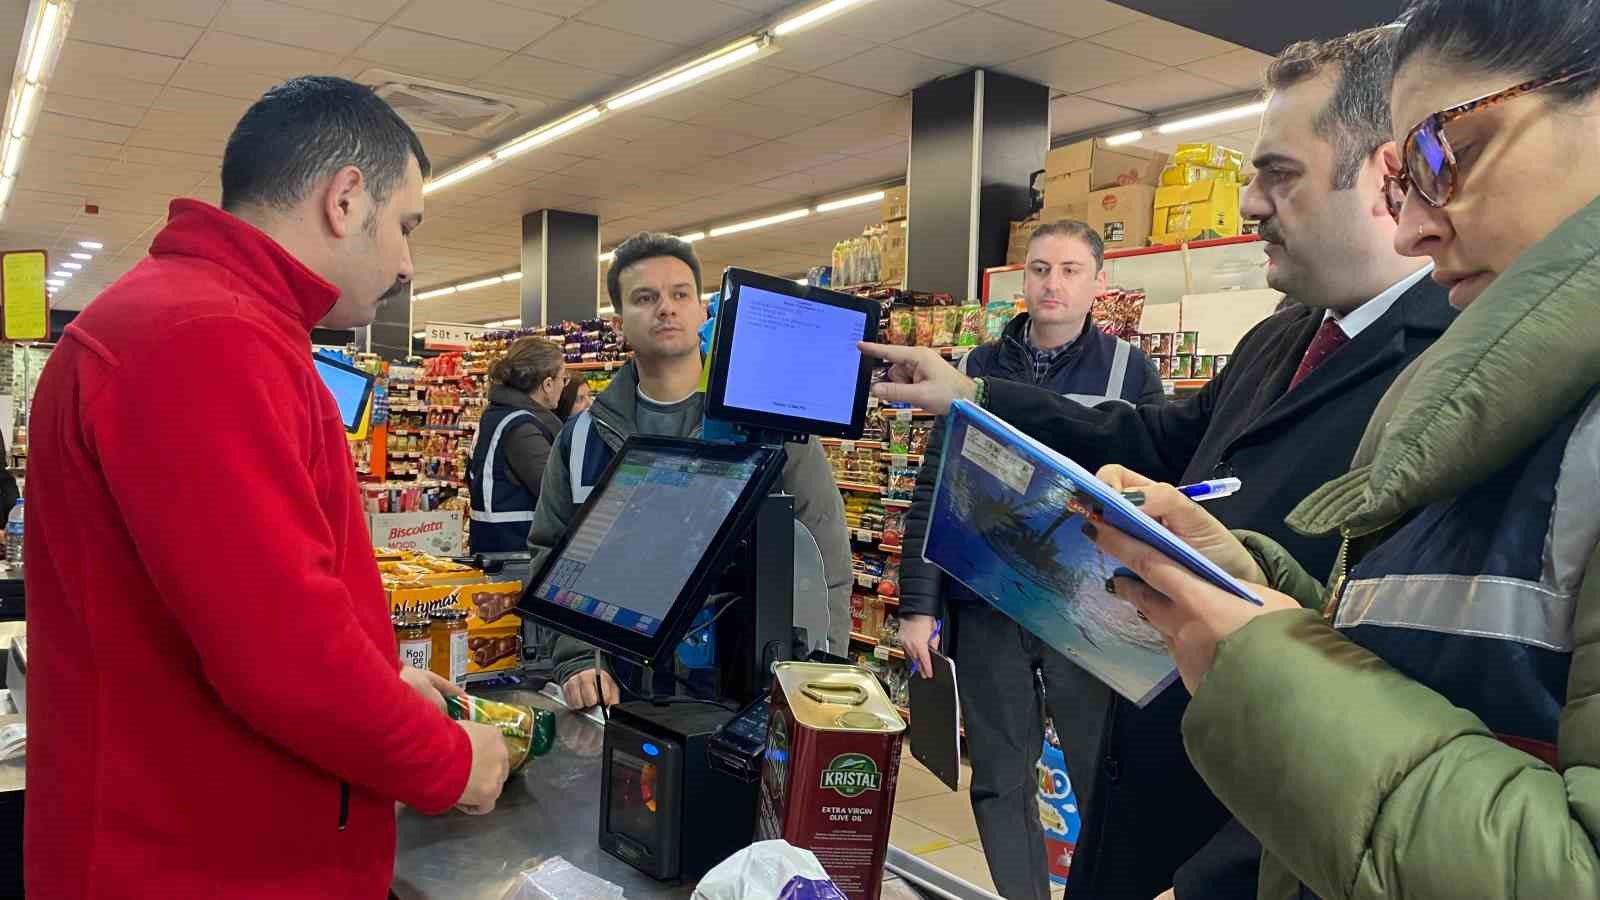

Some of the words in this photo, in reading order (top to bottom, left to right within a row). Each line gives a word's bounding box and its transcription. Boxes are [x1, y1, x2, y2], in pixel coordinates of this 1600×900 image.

[388, 521, 443, 540] Biscolata
[394, 593, 458, 618] Nutymax
[821, 806, 846, 814] EXTRA
[847, 807, 873, 815] VIRGIN
